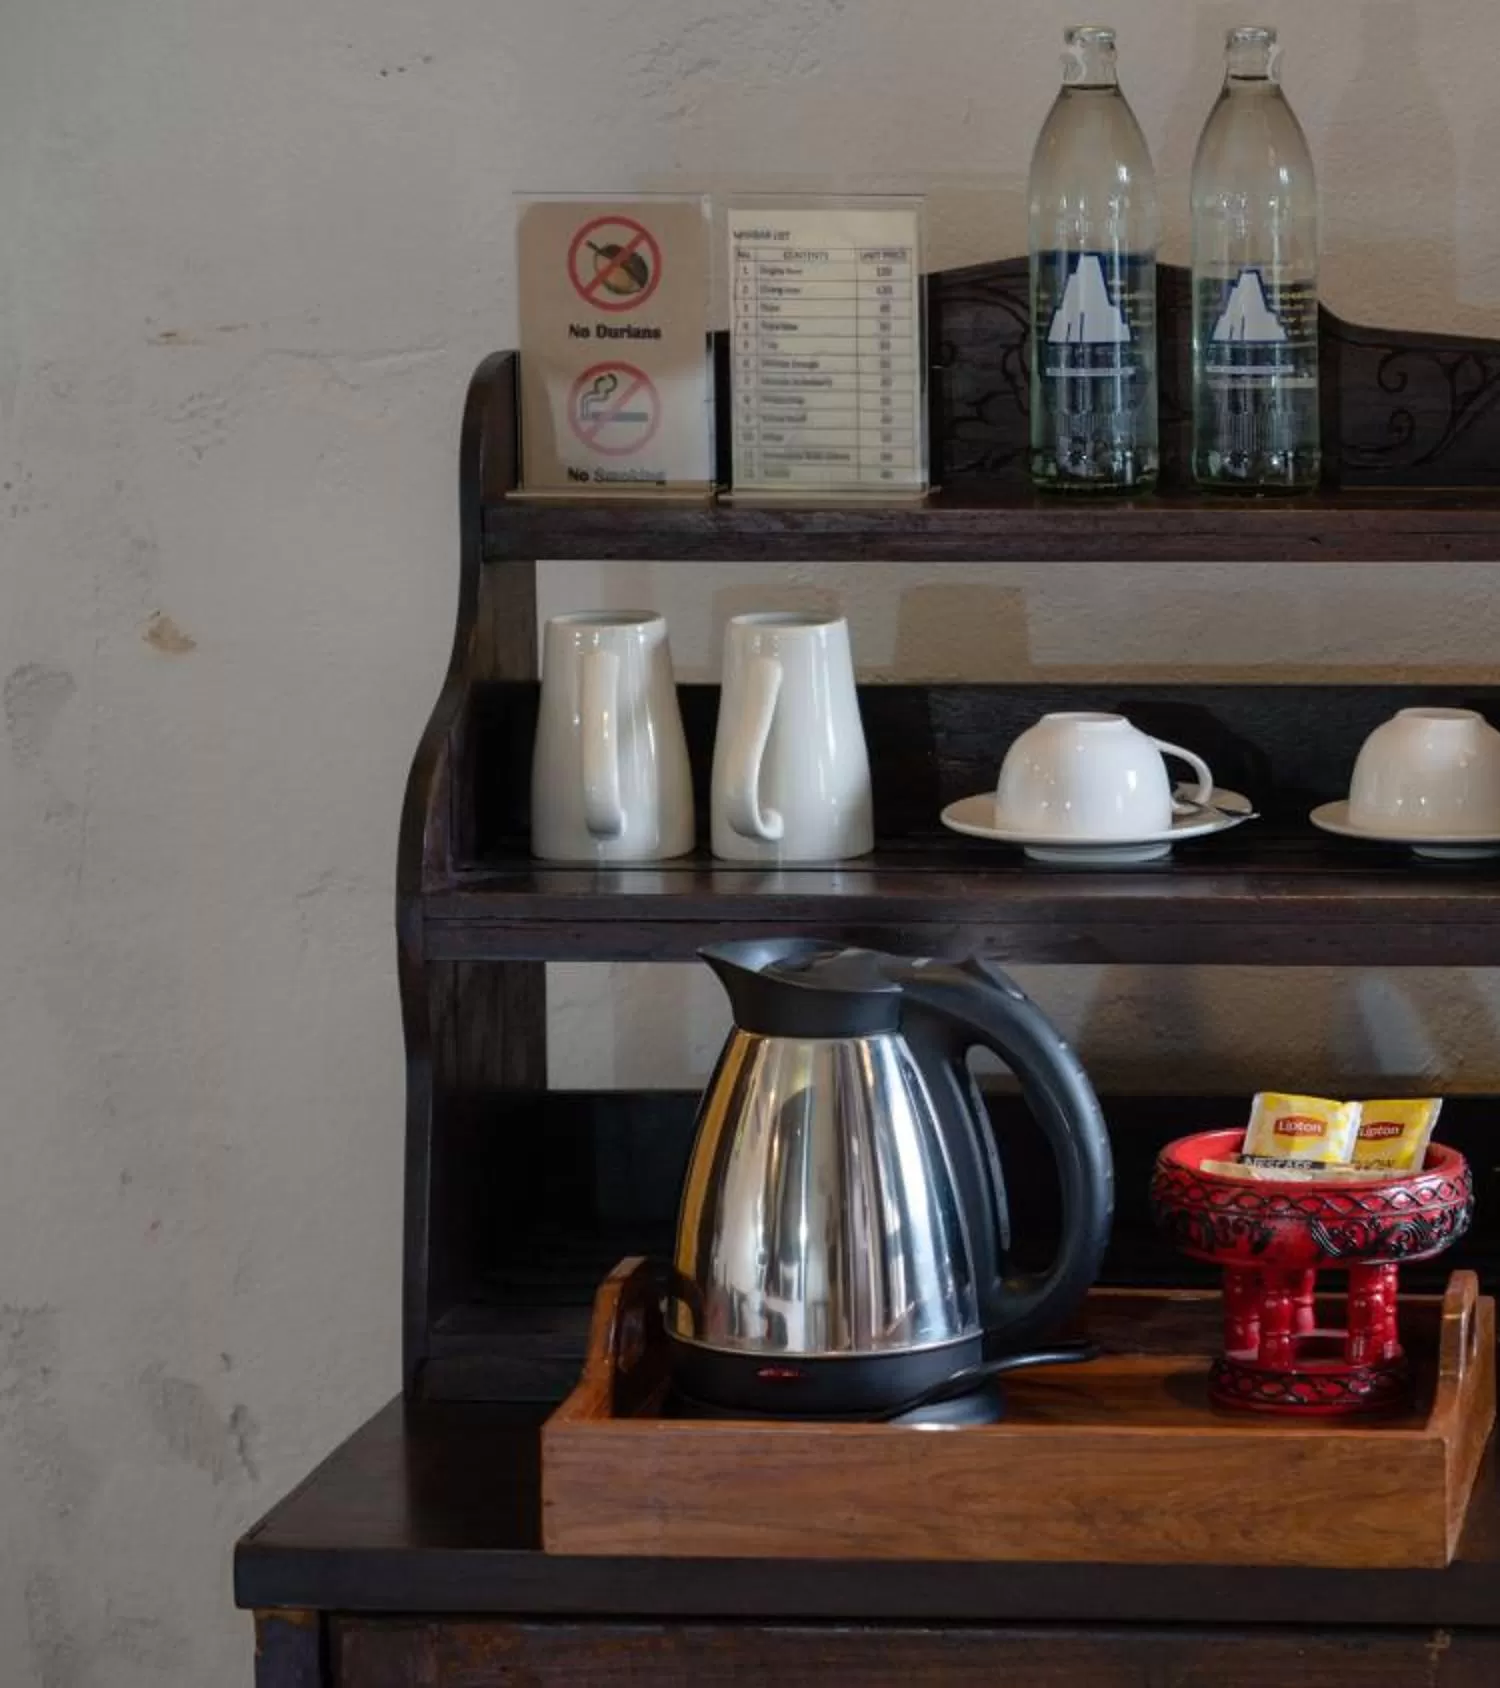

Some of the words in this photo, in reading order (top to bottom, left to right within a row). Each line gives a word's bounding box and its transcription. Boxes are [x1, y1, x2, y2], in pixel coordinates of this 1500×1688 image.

[569, 324, 591, 338] No
[596, 323, 662, 340] Durians
[567, 467, 589, 482] No
[594, 467, 666, 485] Smoking
[1279, 1119, 1322, 1135] Lipton
[1360, 1127, 1400, 1138] Lipton
